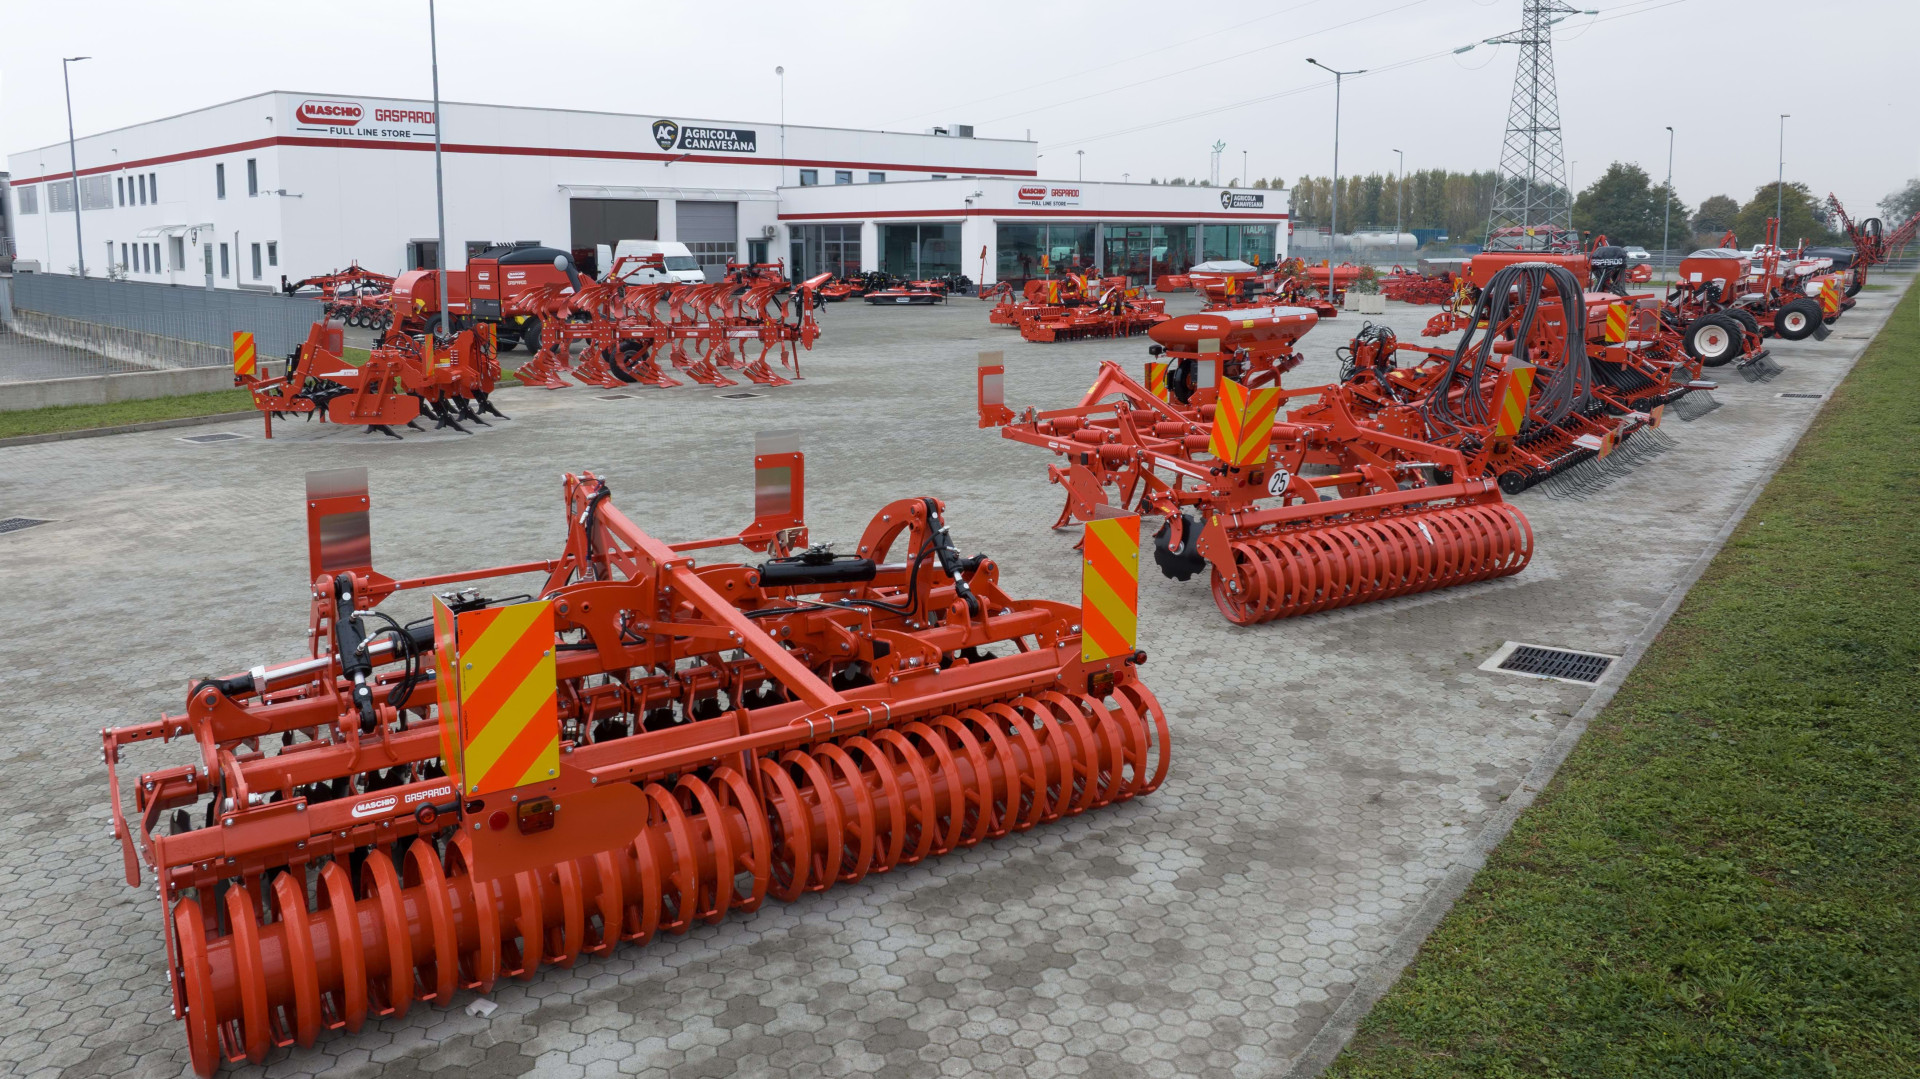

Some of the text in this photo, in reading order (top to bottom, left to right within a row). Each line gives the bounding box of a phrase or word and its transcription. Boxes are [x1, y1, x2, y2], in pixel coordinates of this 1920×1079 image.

[305, 104, 361, 118] MASCHIO
[329, 127, 411, 138] FULL LINE STORE
[656, 125, 675, 140] AC
[685, 128, 738, 140] AGRICOLA
[685, 139, 755, 151] CANAVESANA
[1051, 188, 1079, 197] GASPARDO
[1271, 472, 1288, 493] 25
[357, 786, 451, 811] MASCHIO GASPARDO
